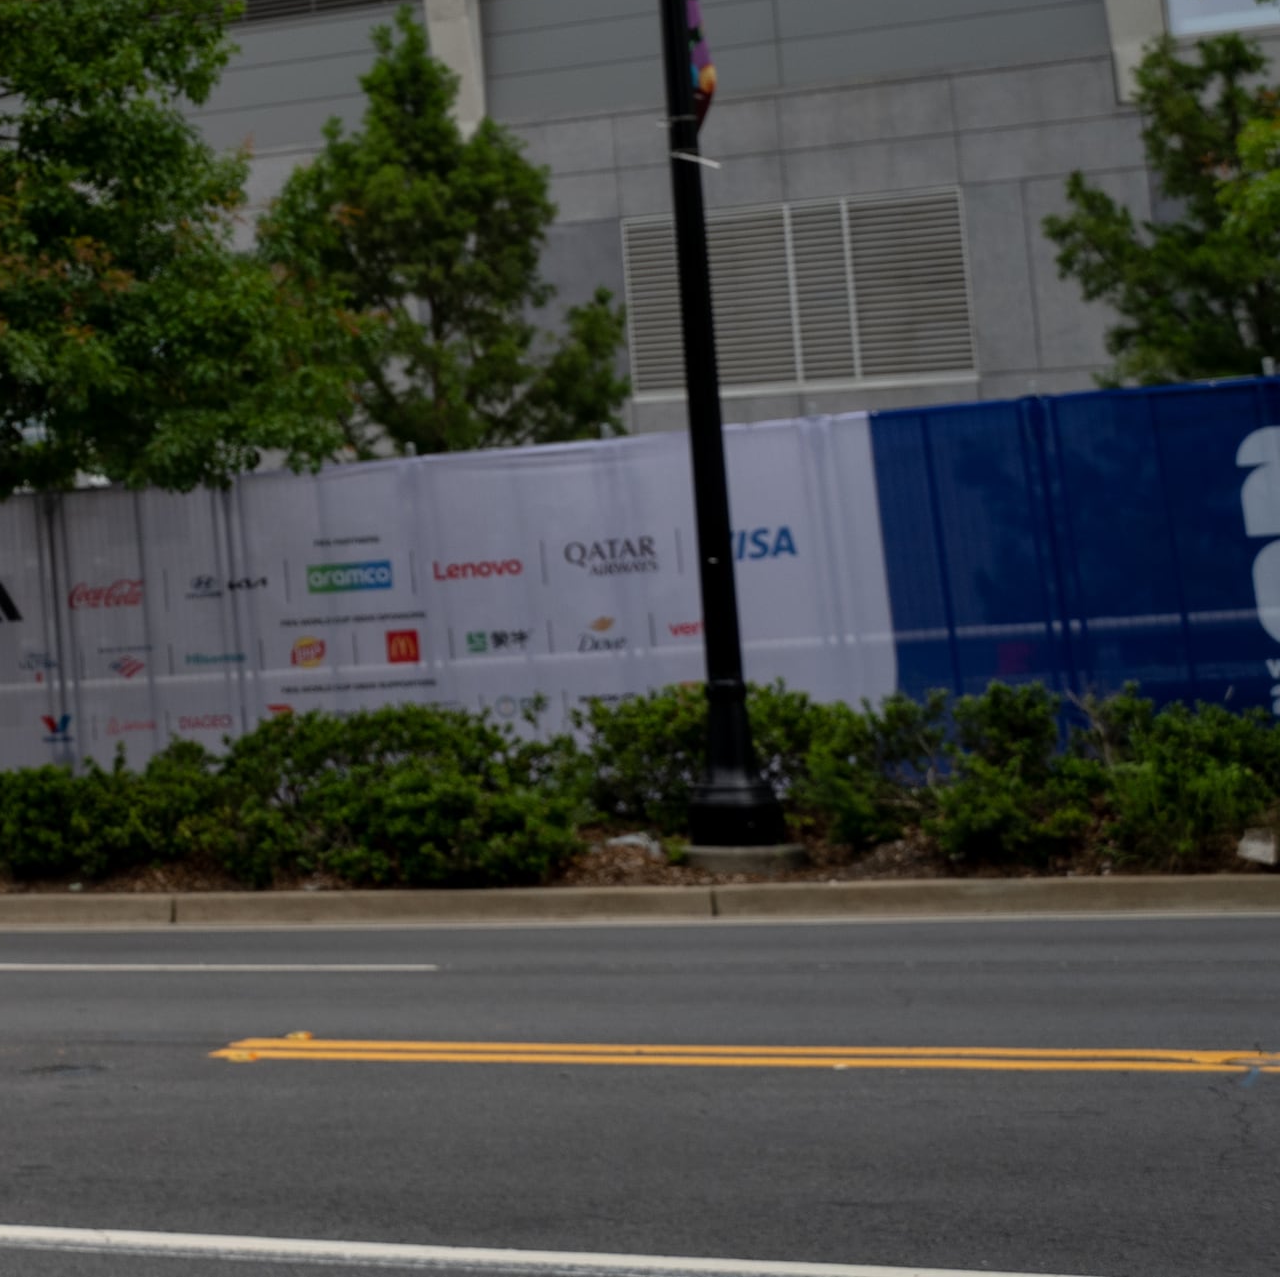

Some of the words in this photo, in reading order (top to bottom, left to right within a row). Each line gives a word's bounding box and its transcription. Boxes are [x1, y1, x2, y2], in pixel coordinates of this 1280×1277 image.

[563, 535, 656, 568] QATAR
[730, 525, 797, 561] ISA
[309, 567, 390, 588] aramco
[433, 558, 522, 581] Lenovo
[588, 560, 659, 577] AIRWAYS
